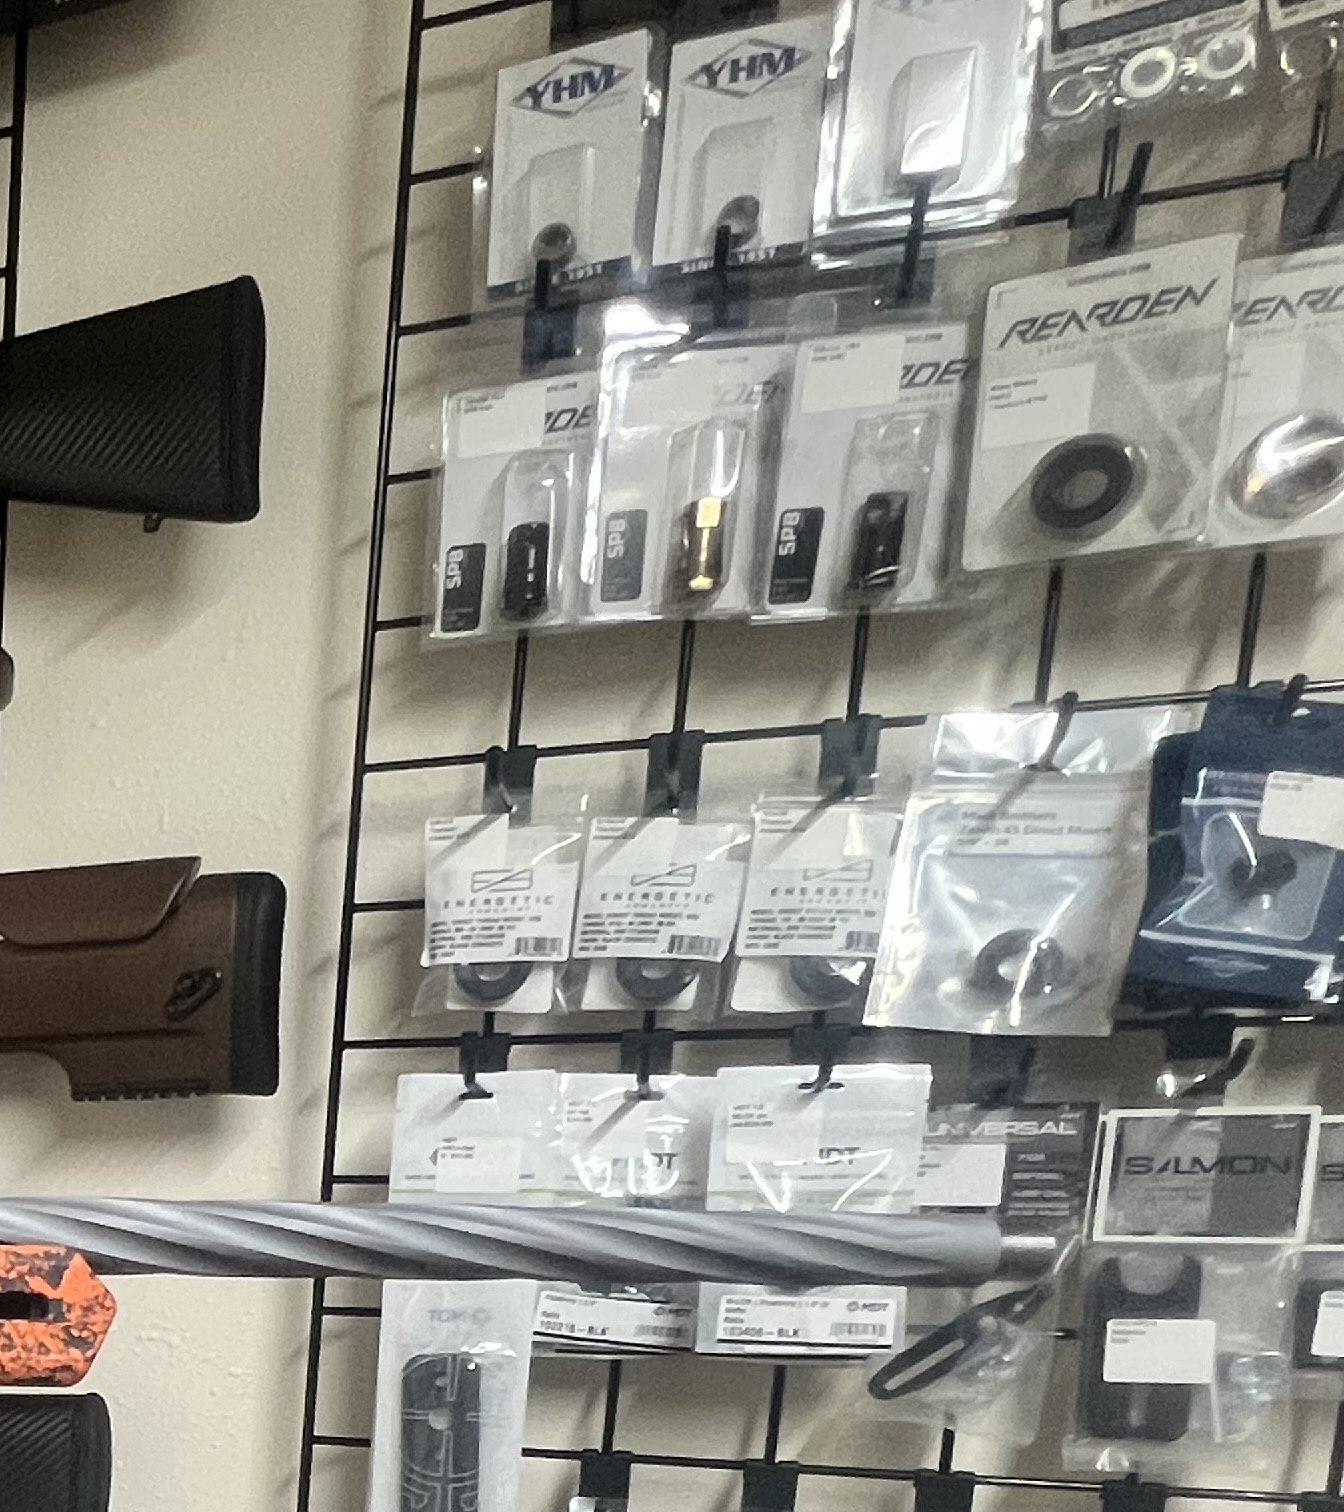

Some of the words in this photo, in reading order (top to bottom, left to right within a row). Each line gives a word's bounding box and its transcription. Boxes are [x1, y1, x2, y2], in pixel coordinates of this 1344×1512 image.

[525, 64, 616, 110] YHM
[699, 47, 796, 88] YHM
[998, 274, 1220, 349] REARDEN
[607, 518, 626, 560] SPB
[779, 511, 801, 556] SPB
[446, 549, 463, 590] SPB
[770, 886, 886, 897] ENERGETI
[925, 1120, 1077, 1136] UNVERSAL
[1123, 1154, 1293, 1176] SALMON
